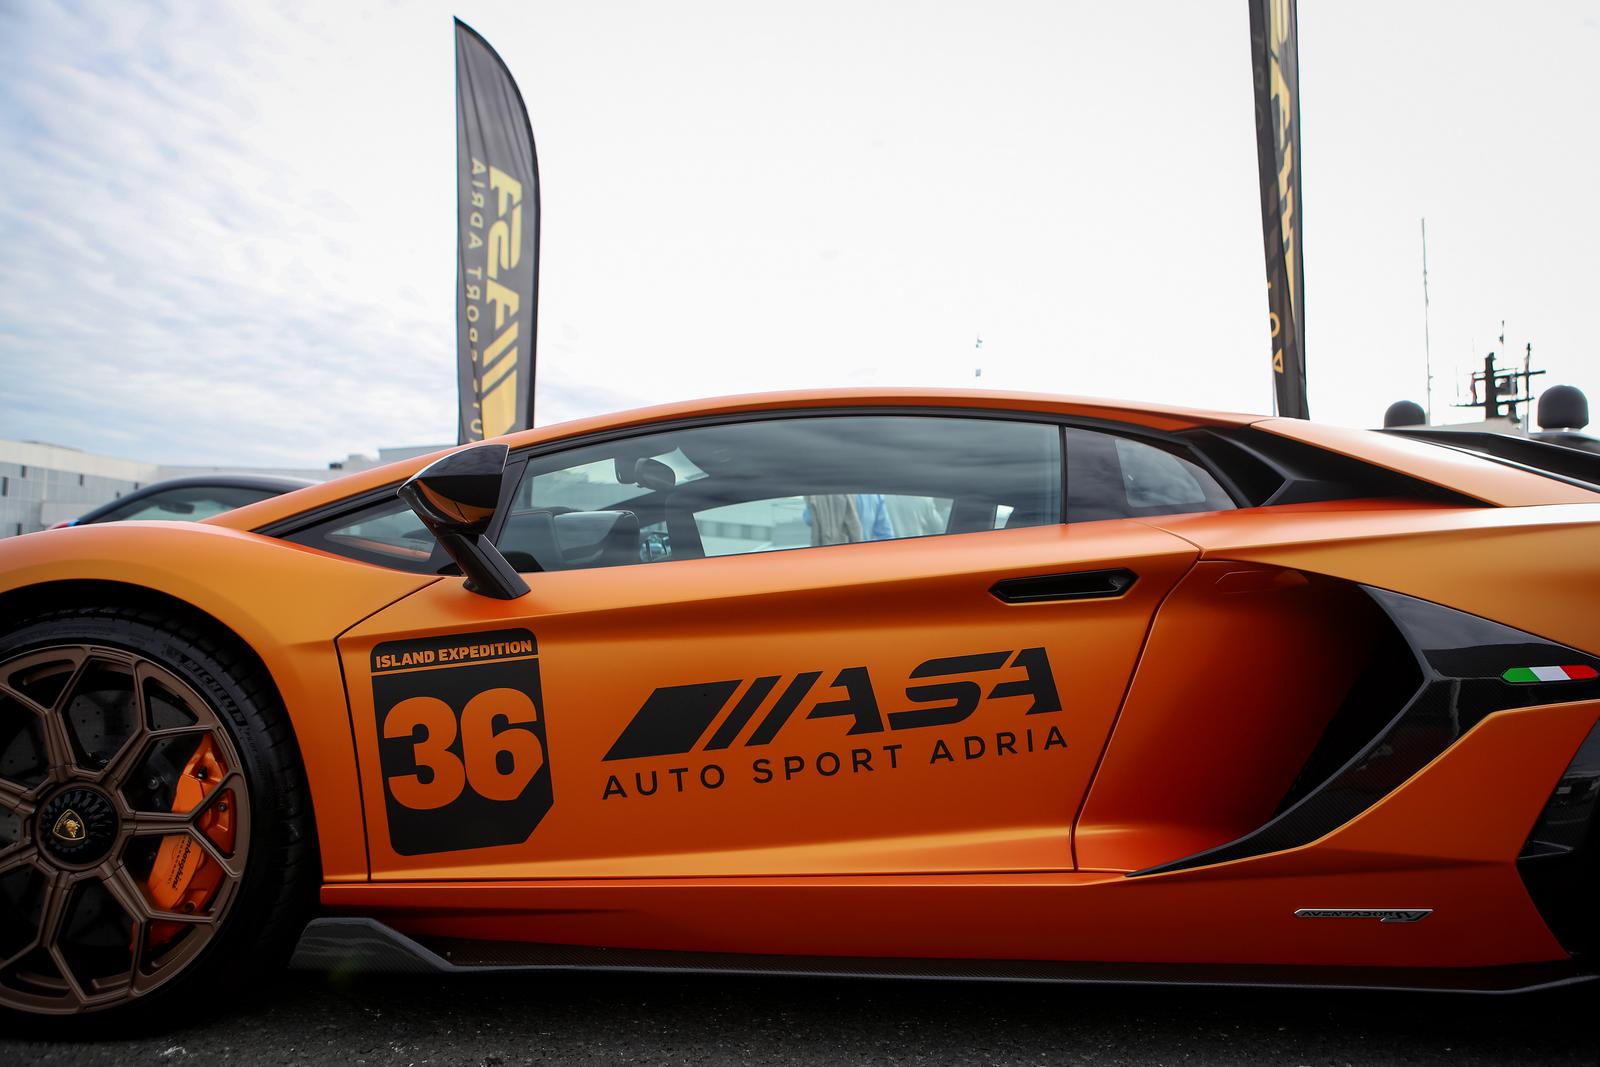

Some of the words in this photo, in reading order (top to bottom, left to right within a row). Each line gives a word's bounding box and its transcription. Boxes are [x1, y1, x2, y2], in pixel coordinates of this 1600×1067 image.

[375, 651, 435, 669] ISLAND
[438, 639, 533, 662] EXPEDITION
[383, 687, 543, 811] 36
[601, 763, 726, 800] AUTO
[753, 744, 903, 785] SPORT
[929, 725, 1068, 765] ADRIA
